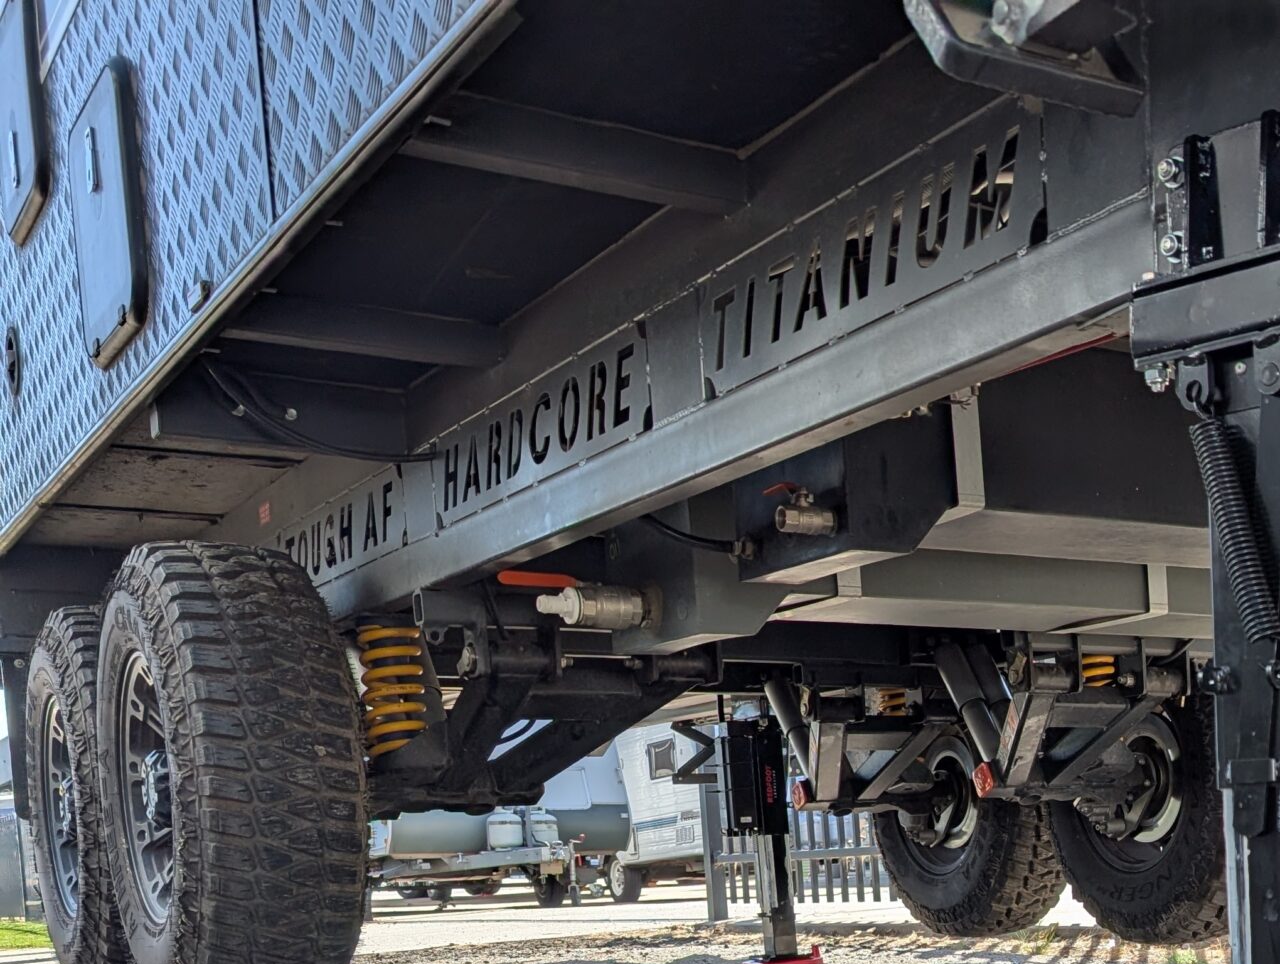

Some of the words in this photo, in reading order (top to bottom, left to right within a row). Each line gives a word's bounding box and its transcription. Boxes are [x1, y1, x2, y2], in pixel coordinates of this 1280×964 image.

[713, 124, 1020, 373] TITANIUM
[444, 342, 635, 513] HARDCORE
[363, 481, 393, 552] AF
